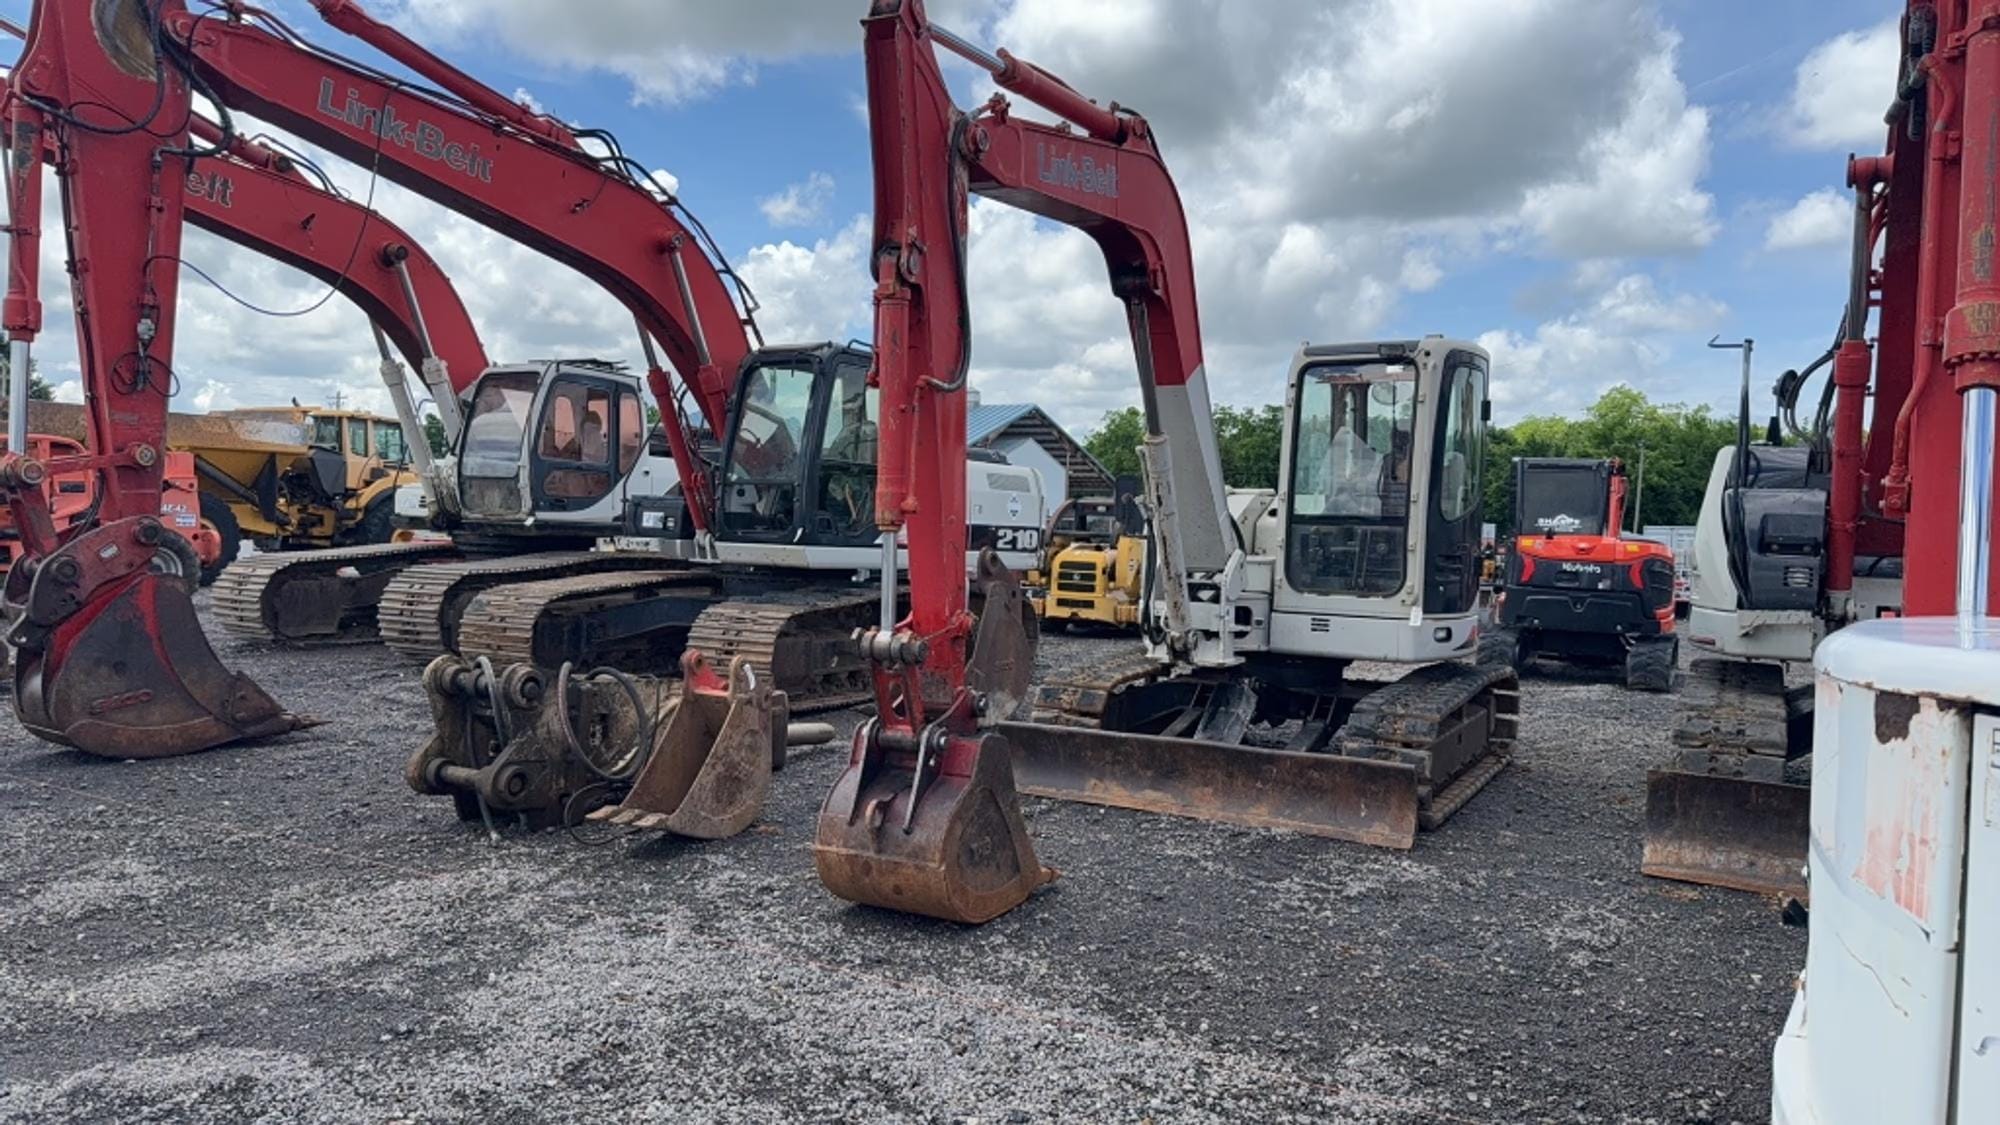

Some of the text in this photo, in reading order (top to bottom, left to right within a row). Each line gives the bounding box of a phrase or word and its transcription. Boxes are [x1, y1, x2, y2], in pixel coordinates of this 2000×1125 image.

[1037, 143, 1119, 198] Link-Belt
[996, 529, 1038, 550] 210
[1562, 562, 1601, 574] Kubota
